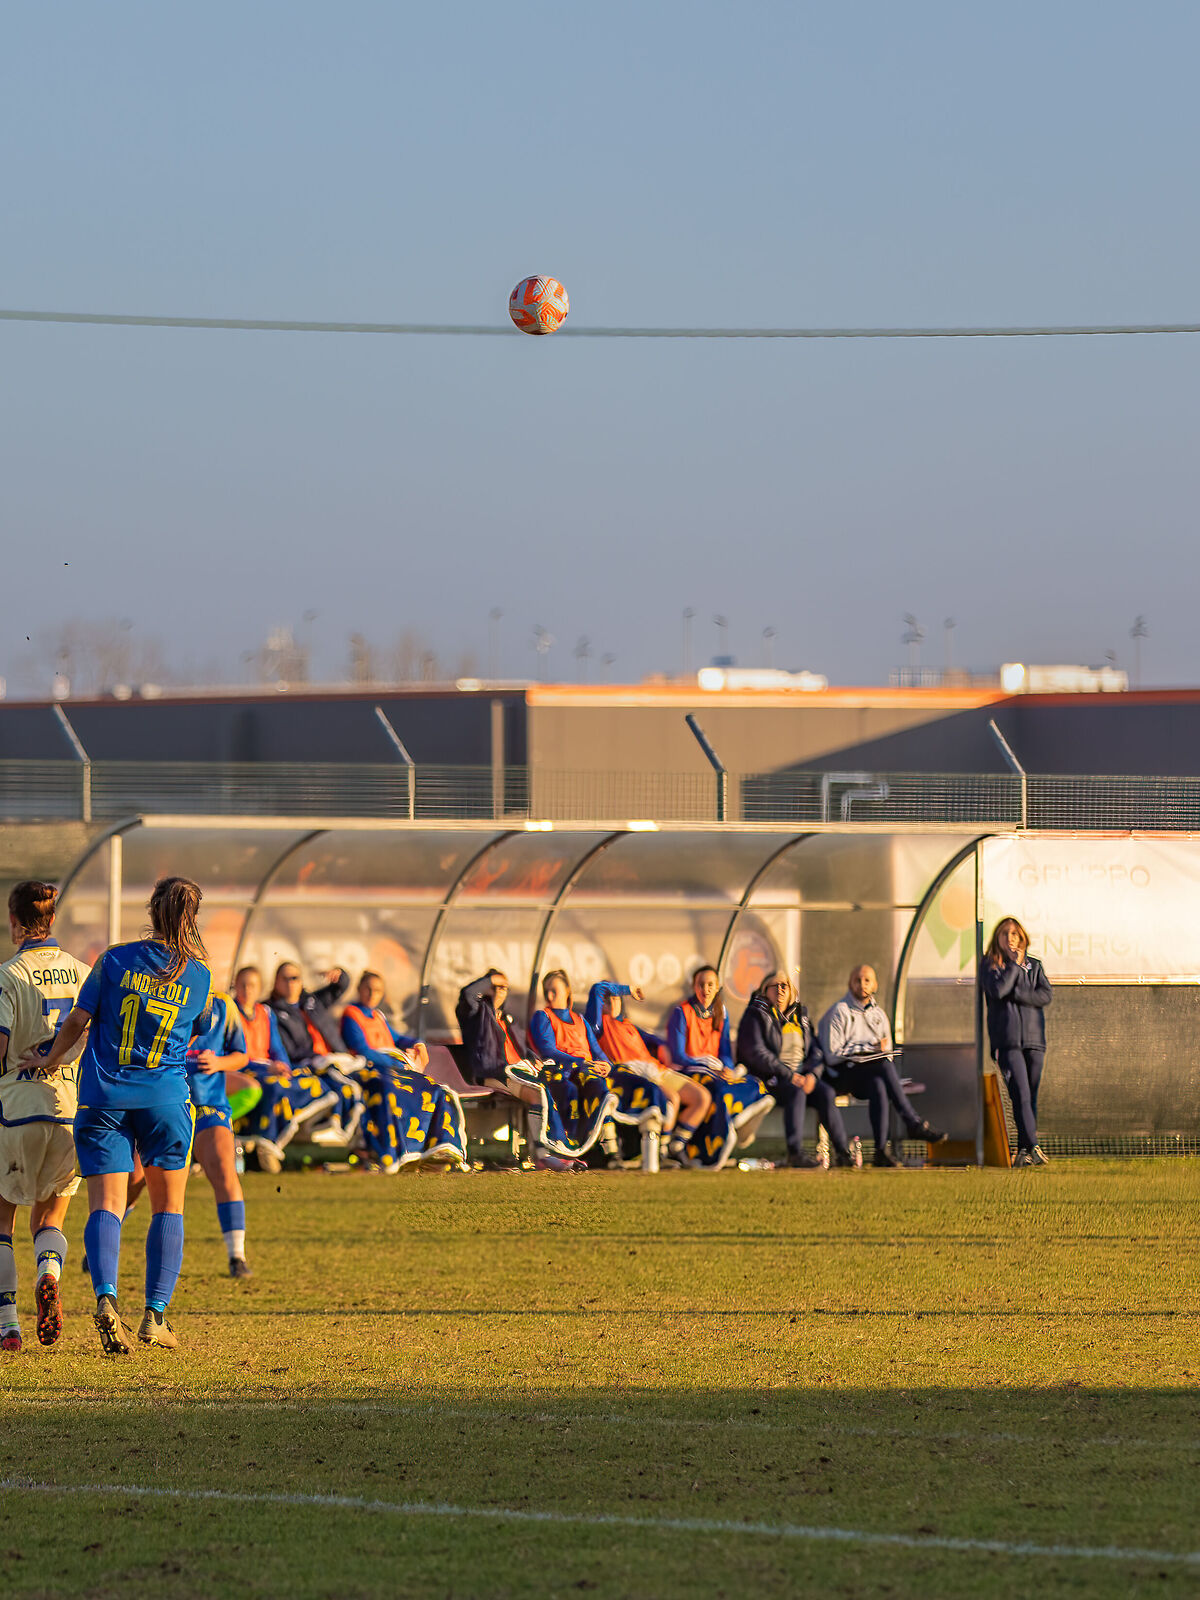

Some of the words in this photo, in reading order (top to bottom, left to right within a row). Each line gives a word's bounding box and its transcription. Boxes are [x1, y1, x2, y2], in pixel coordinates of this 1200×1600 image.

[32, 968, 78, 987] SARDU
[119, 969, 191, 1006] ANDREOLI
[118, 993, 180, 1069] 17
